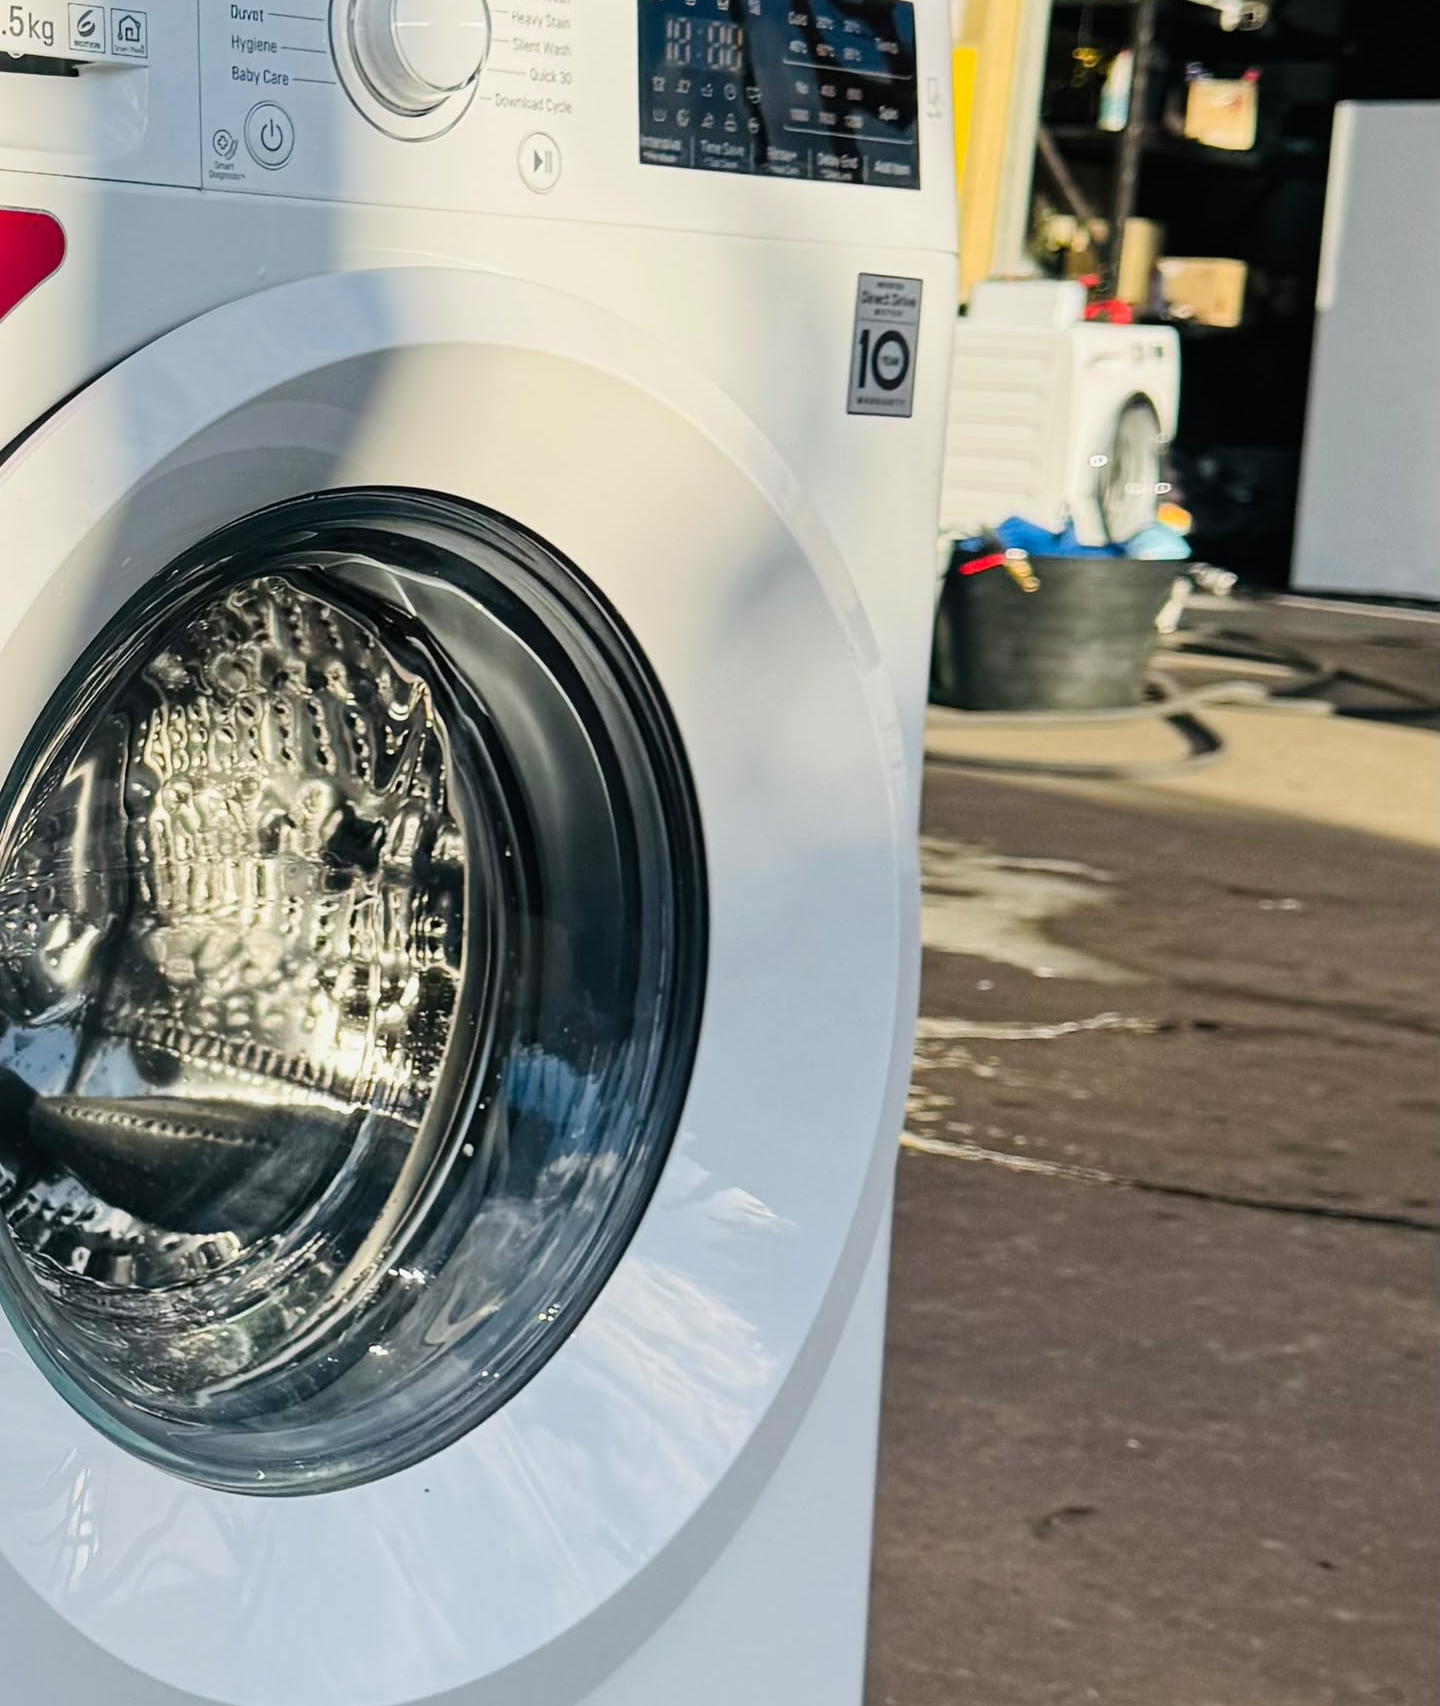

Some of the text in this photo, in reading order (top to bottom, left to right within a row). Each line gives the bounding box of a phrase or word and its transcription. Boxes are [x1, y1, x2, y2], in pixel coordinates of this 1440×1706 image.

[231, 36, 278, 56] Hygiene
[232, 66, 289, 86] Baby Care
[857, 329, 909, 391] 10
